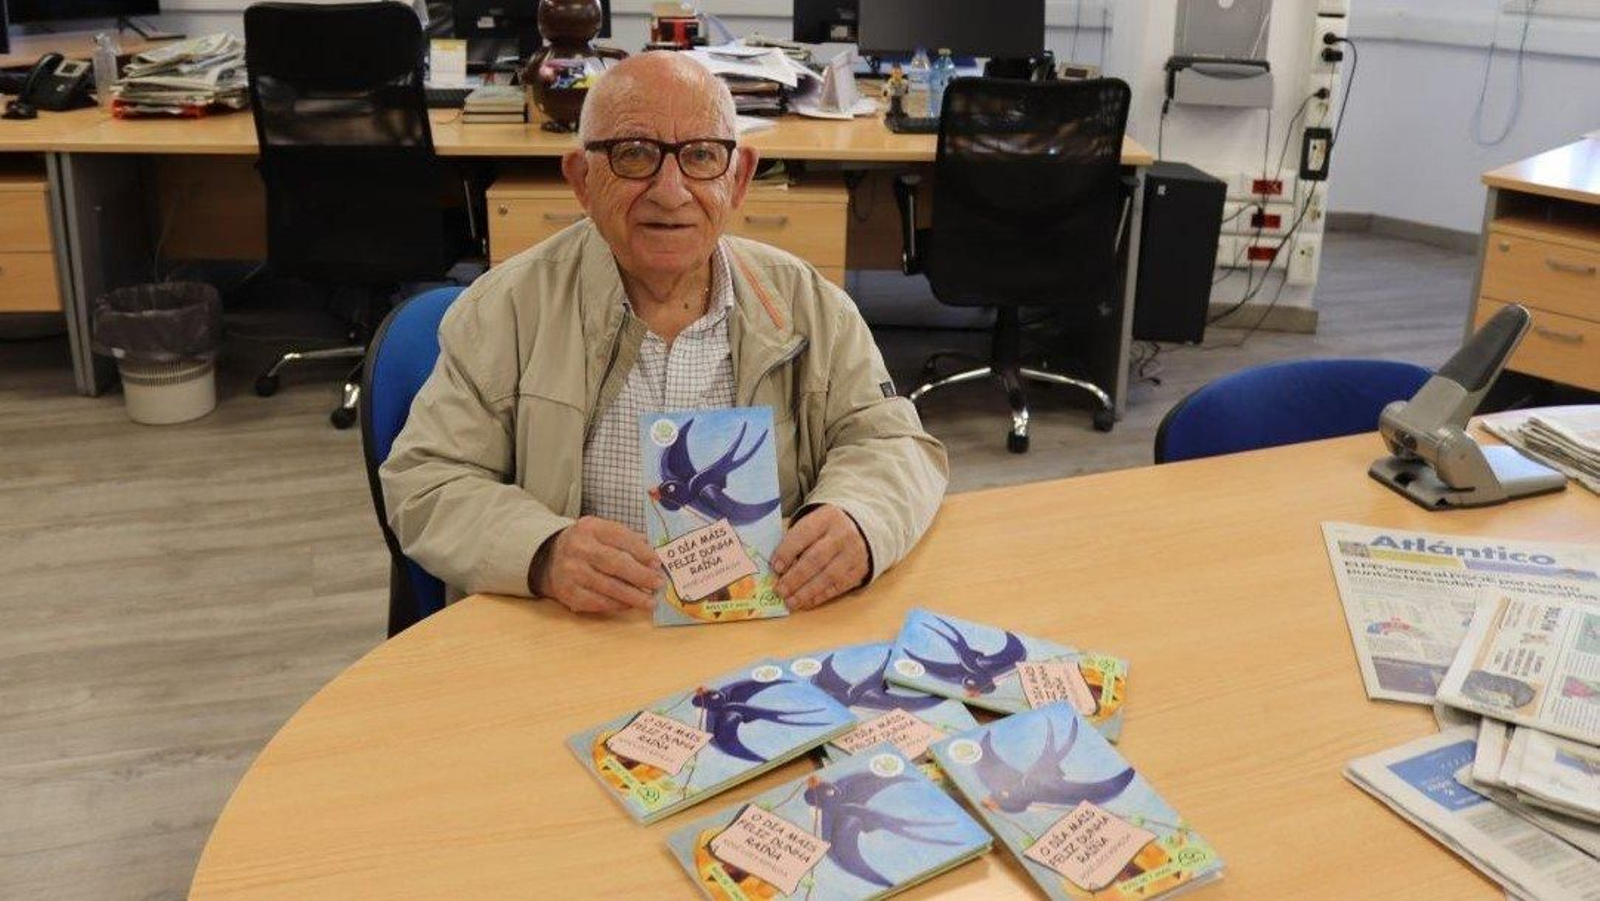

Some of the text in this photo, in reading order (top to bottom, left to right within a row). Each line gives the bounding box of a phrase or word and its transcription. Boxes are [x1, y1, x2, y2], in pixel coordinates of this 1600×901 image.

[667, 549, 675, 558] O
[667, 538, 734, 571] FELIZ DUNHA
[1370, 535, 1556, 566] Atlántico
